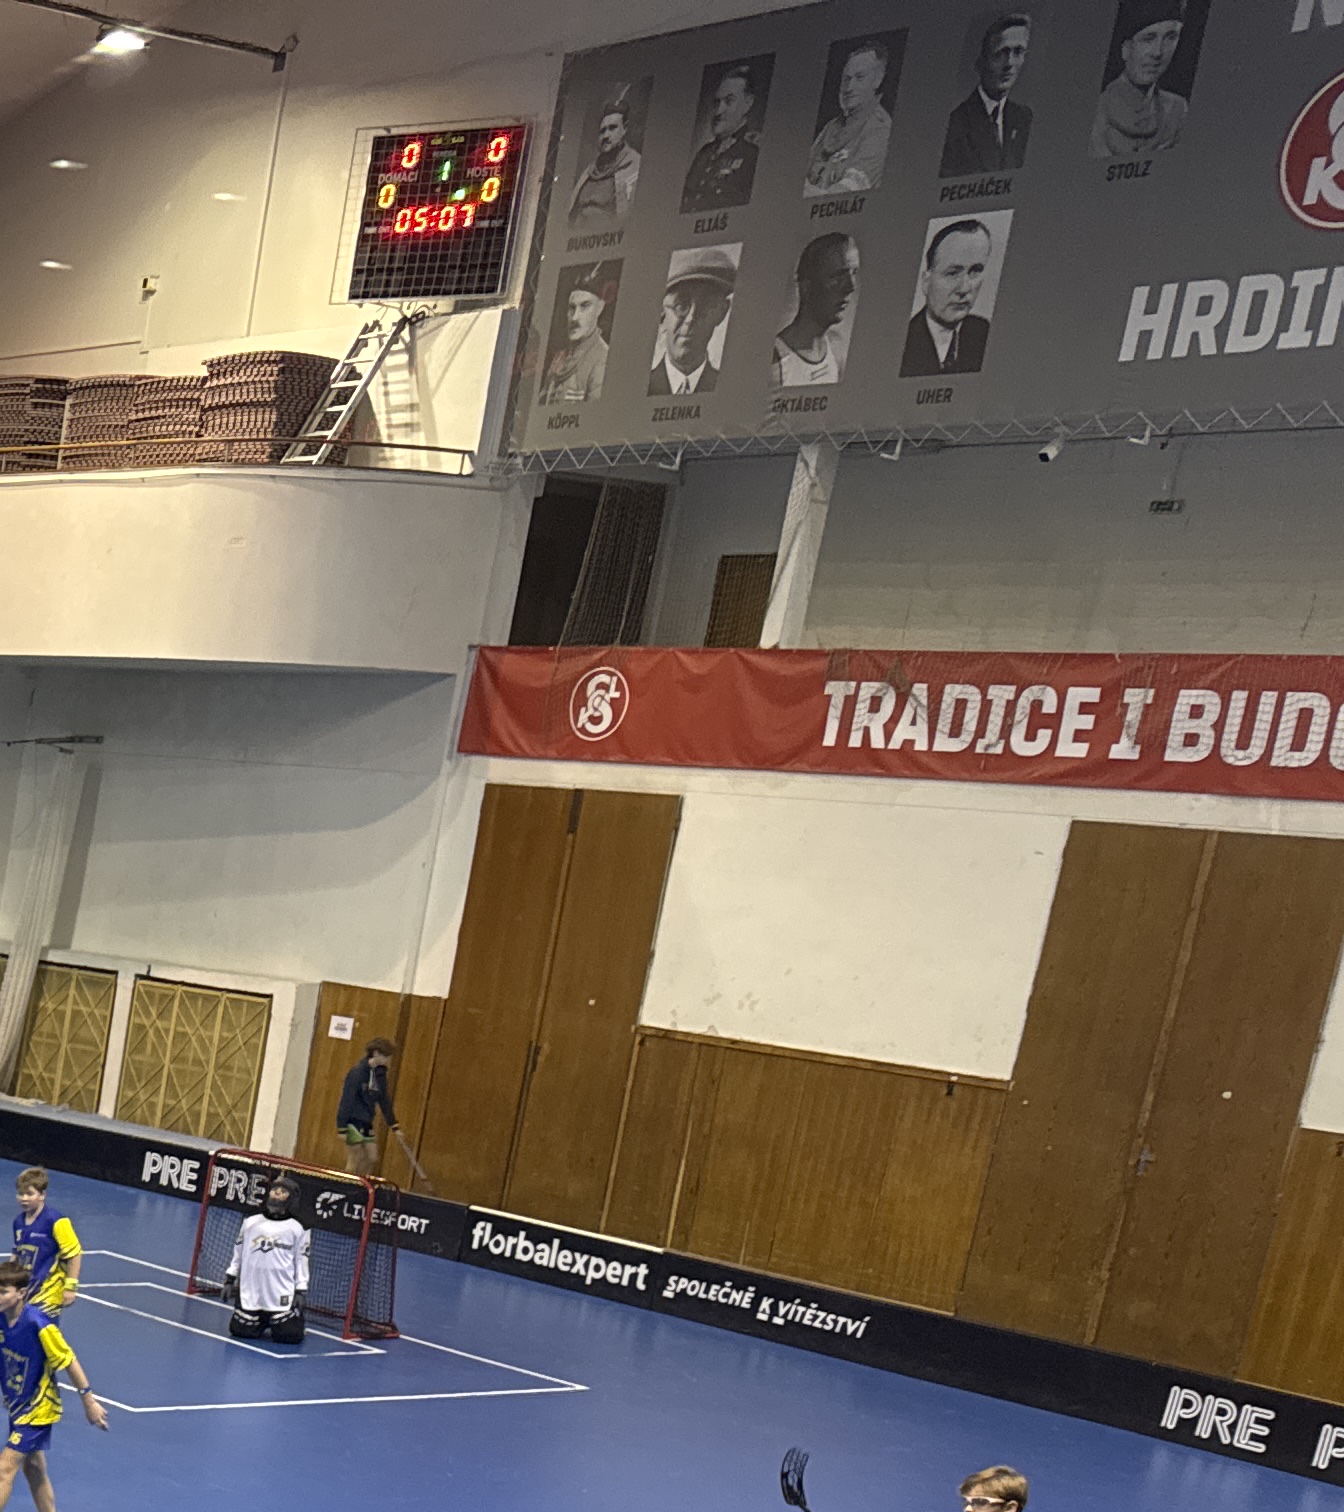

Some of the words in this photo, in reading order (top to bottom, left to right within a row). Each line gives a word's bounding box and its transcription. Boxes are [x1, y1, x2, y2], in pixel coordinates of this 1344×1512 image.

[1106, 160, 1152, 182] STOLZ
[940, 178, 1012, 203] PECHÁČEK
[394, 204, 475, 233] 05:07
[693, 212, 729, 234] ELIÁŠ
[916, 387, 953, 405] UHER
[547, 413, 580, 430] KÖPPL
[651, 405, 701, 422] ZELENKA
[821, 680, 1101, 758] TRADICE
[1107, 687, 1156, 761] I
[141, 1151, 200, 1192] PRE
[210, 1165, 269, 1207] PRE
[471, 1220, 650, 1292] florbalexpert
[664, 1275, 756, 1310] SPOLEČNĚ
[760, 1296, 775, 1317] K
[776, 1299, 871, 1340] VÍTĚZSTVÍ
[1160, 1385, 1276, 1454] PRE
